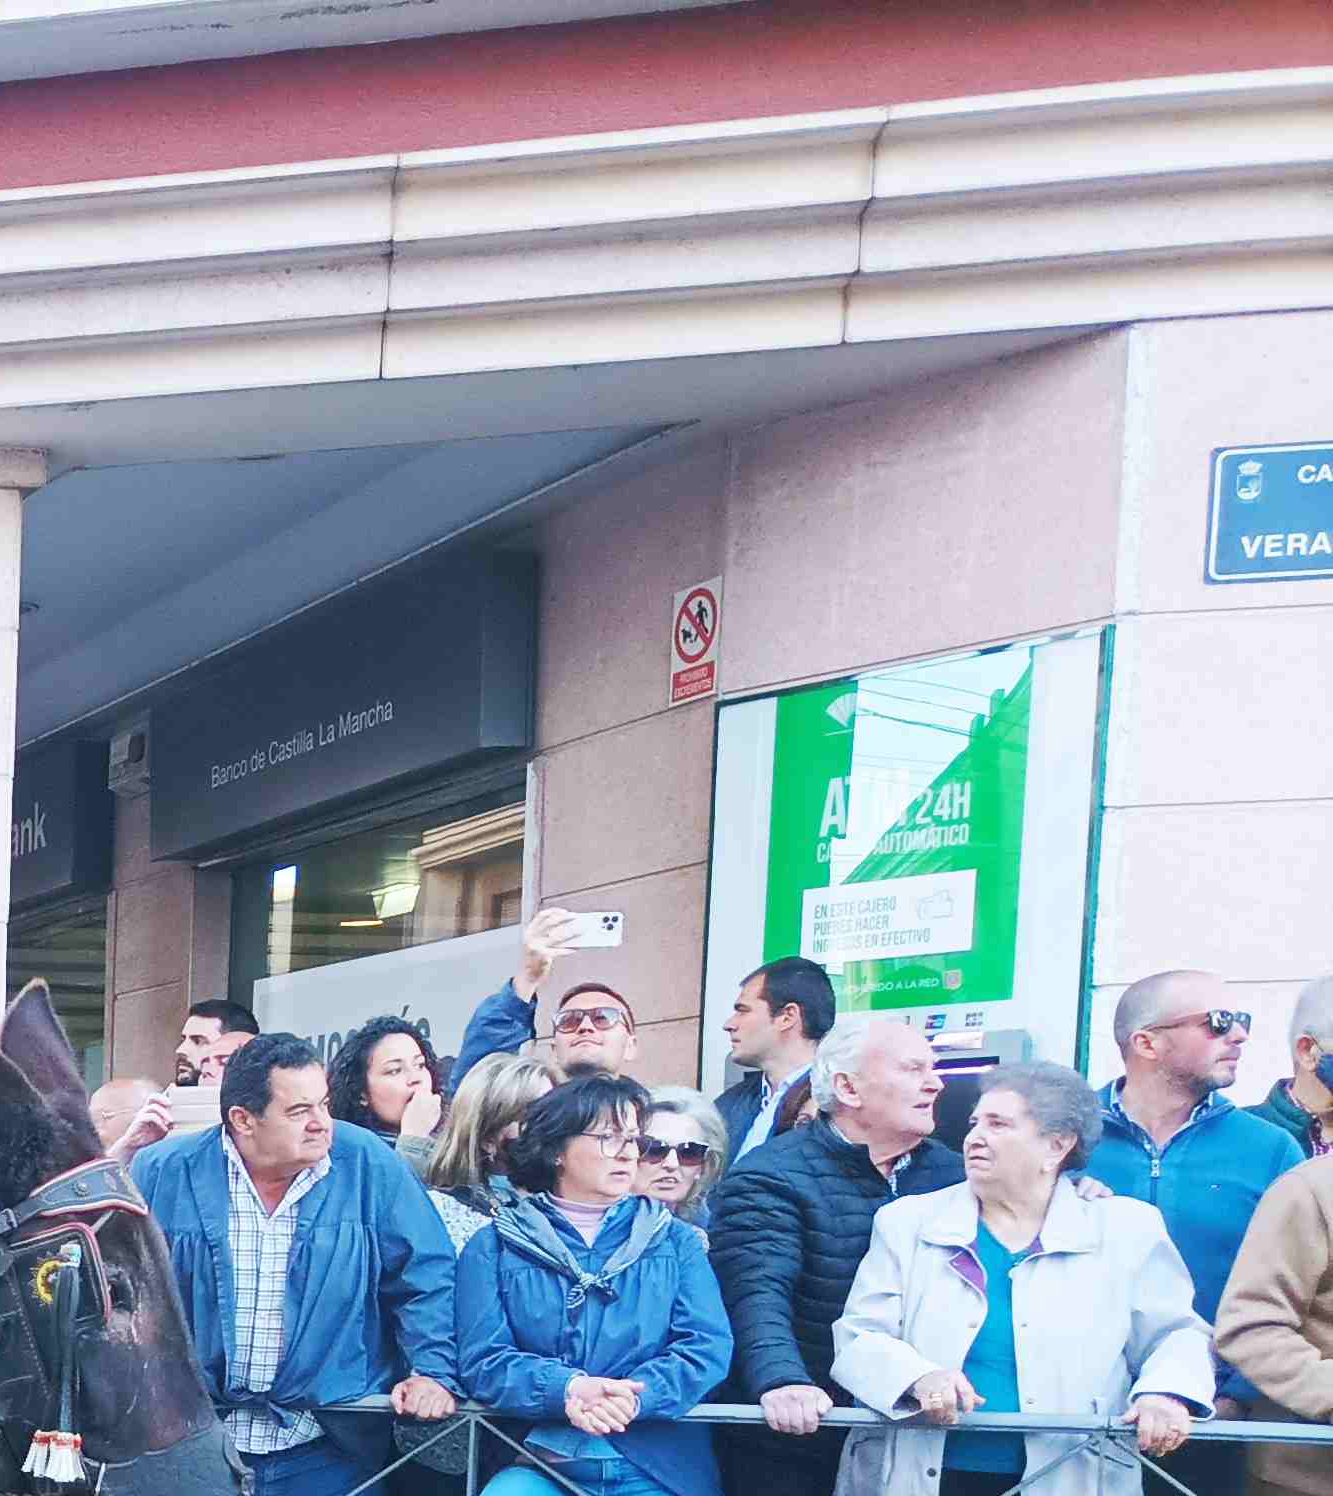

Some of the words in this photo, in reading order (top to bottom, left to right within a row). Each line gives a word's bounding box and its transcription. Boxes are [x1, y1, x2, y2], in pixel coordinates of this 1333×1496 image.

[1297, 463, 1333, 484] CA
[1240, 531, 1332, 560] VERA
[210, 758, 248, 789] Banco
[250, 748, 266, 772] de
[267, 727, 314, 766] Castilla
[318, 722, 335, 747] La
[337, 698, 394, 740] Mancha
[915, 779, 972, 825] 24H
[813, 903, 828, 919] EN
[857, 896, 897, 915] CAJERO
[854, 914, 890, 932] HACER
[880, 927, 932, 946] EFECTIVO
[904, 980, 917, 990] LA
